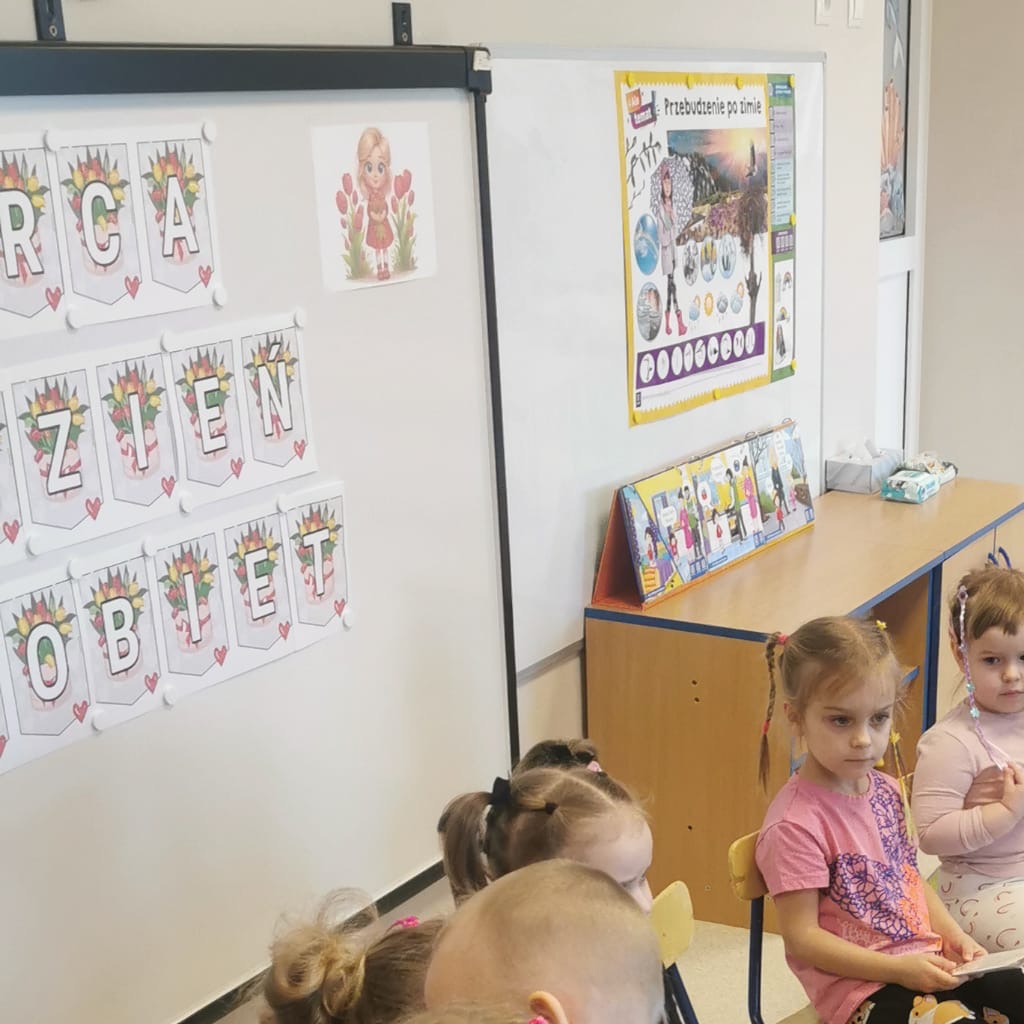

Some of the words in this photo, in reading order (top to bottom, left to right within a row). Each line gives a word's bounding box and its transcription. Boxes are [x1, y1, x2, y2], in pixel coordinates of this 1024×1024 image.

[664, 97, 725, 116] Przebudzenie
[727, 100, 738, 119] po
[740, 97, 762, 115] zimie
